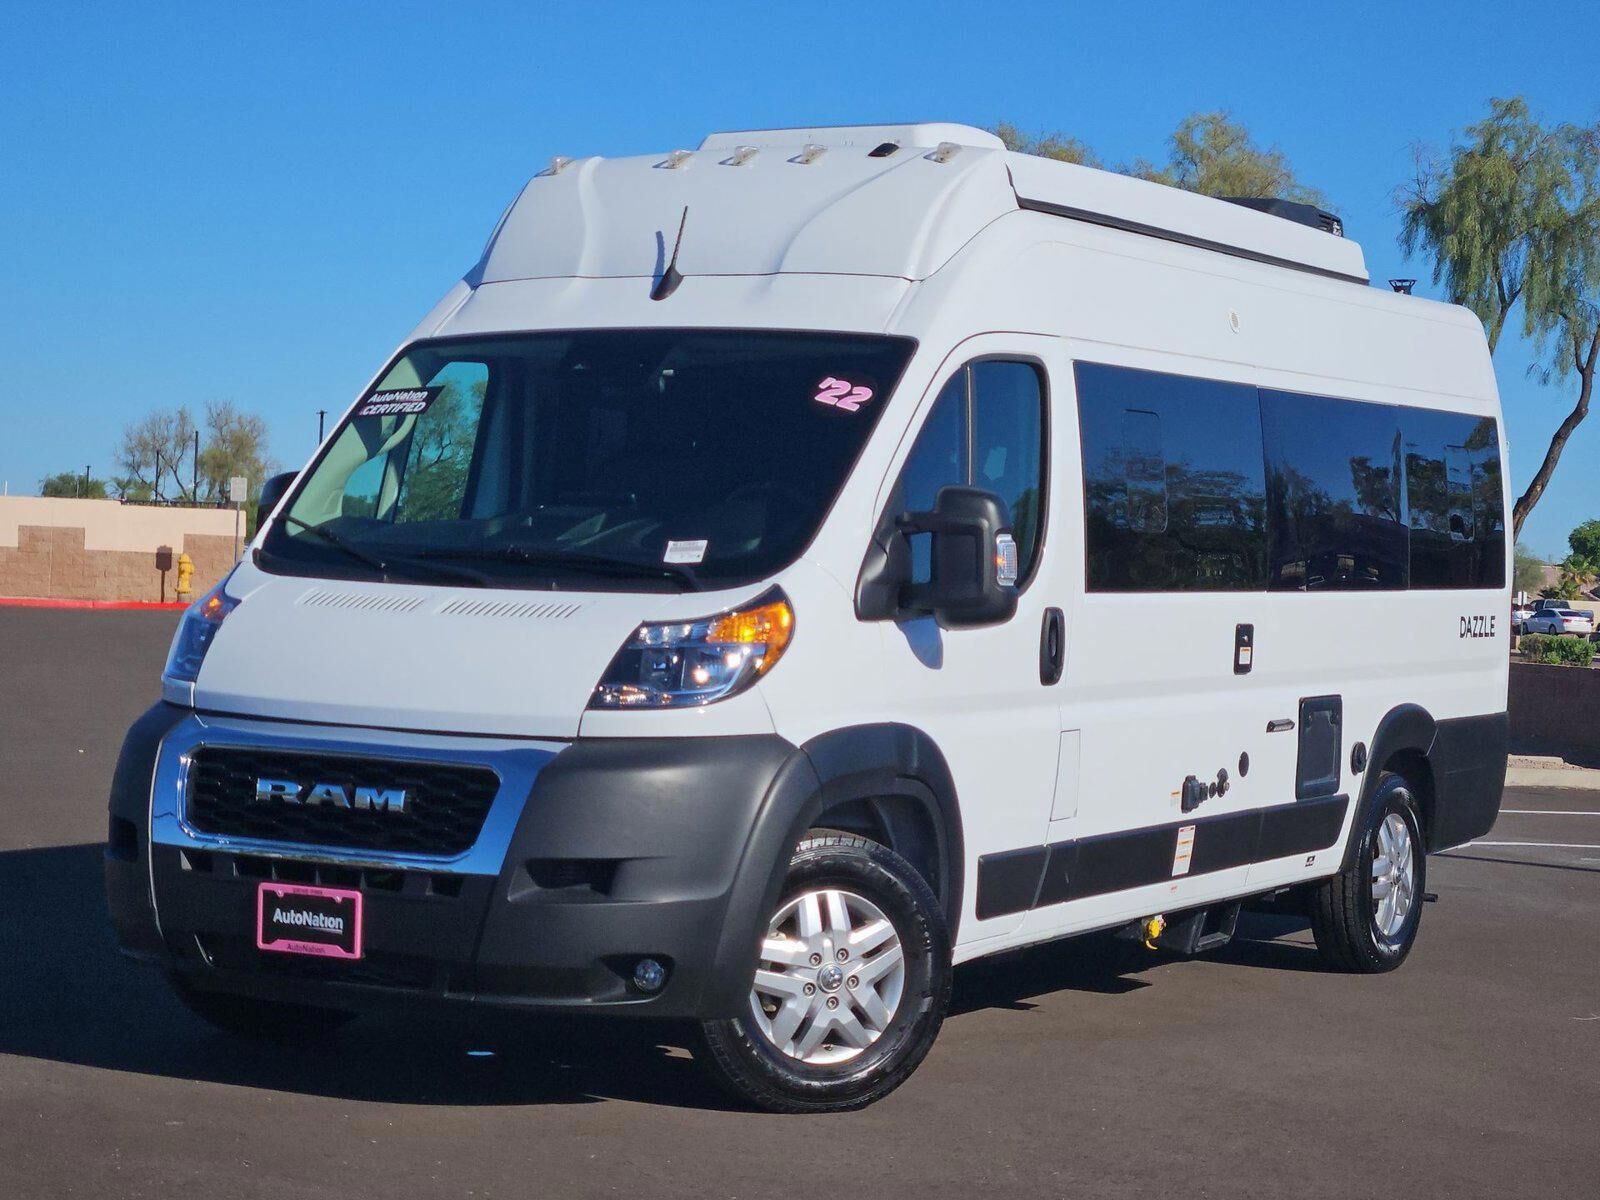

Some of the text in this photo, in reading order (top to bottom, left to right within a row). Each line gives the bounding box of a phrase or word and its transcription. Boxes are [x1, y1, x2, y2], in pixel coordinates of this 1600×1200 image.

[367, 390, 429, 403] AutoNation
[814, 376, 873, 413] '22
[362, 401, 427, 415] CERTIFIED
[1459, 615, 1496, 638] DAZZLE
[255, 777, 406, 812] RAM
[272, 907, 344, 929] AutoNation
